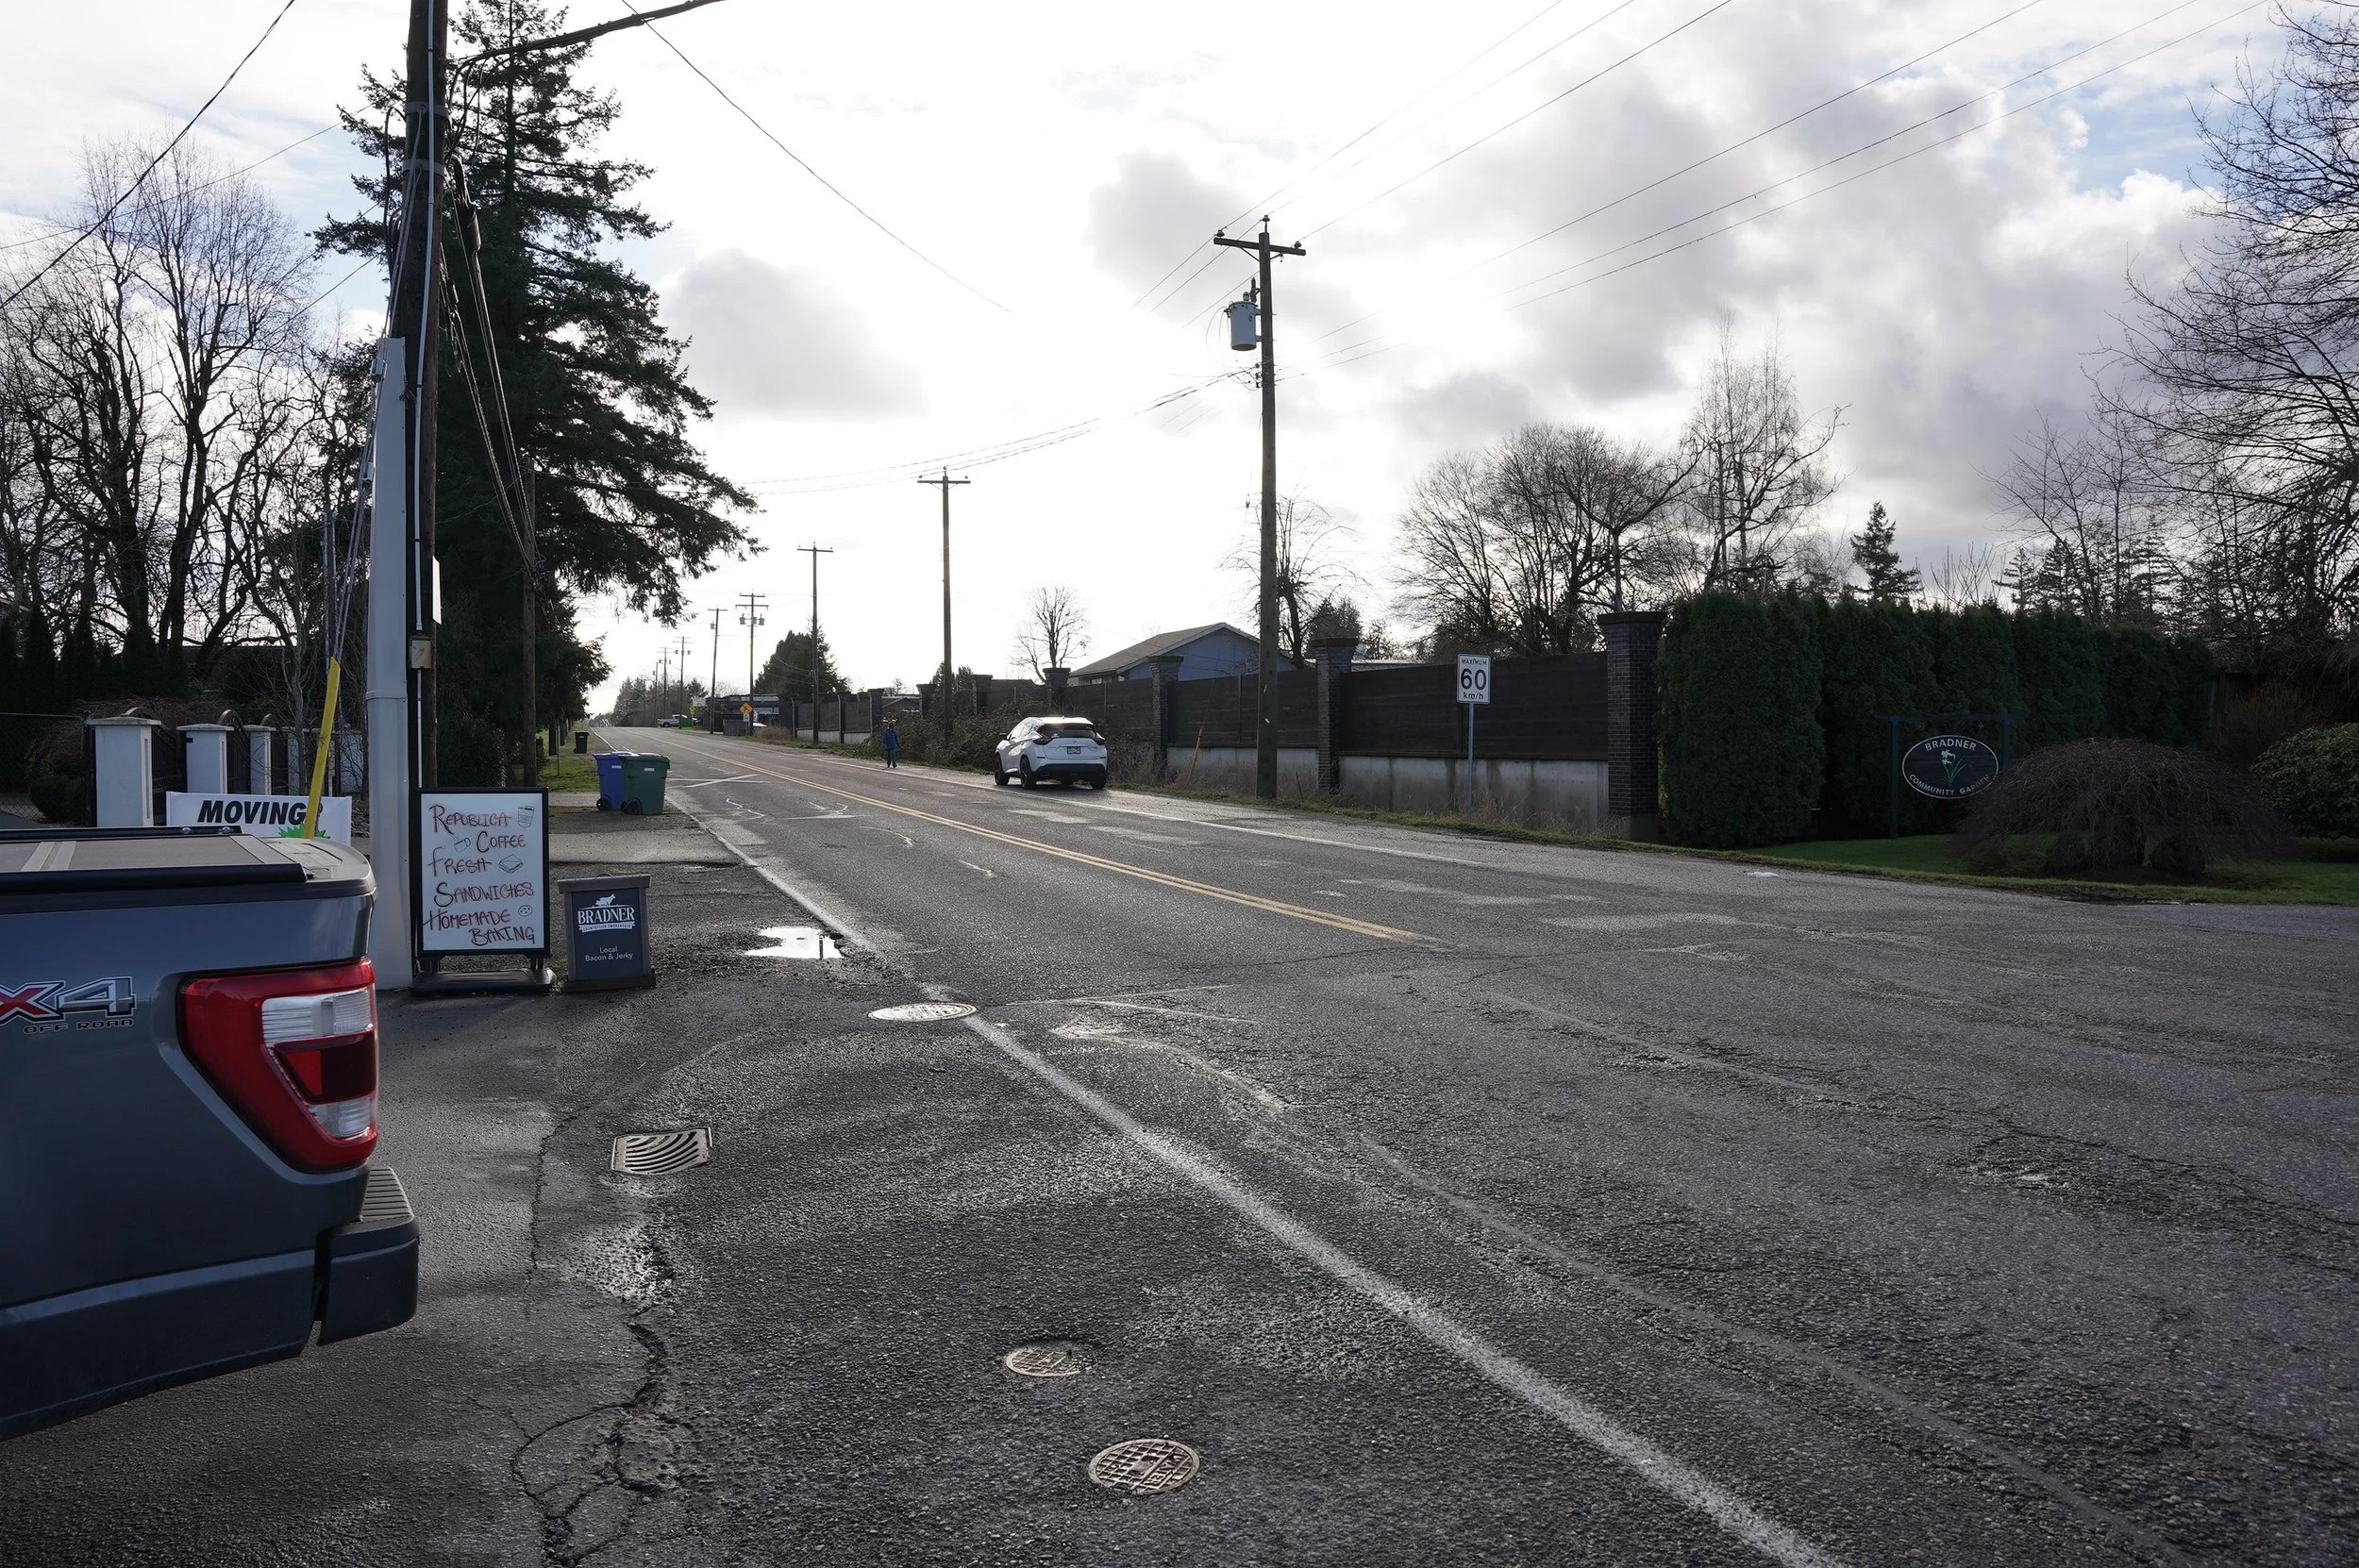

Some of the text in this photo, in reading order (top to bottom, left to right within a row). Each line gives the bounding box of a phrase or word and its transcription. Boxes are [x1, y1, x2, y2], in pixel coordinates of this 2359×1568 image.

[1461, 668, 1487, 691] 60
[1464, 692, 1483, 700] km/h
[1924, 738, 1977, 751] BRADNER
[1909, 774, 1954, 795] COMMUNITY
[428, 805, 512, 835] REPUBLICA
[477, 831, 527, 853] COFFEE
[427, 846, 493, 877] FRESH
[434, 881, 535, 908] SANDWICHES
[423, 909, 510, 931] HOMEMADE
[577, 907, 635, 925] BRADNER
[468, 926, 535, 946] BAKING
[599, 945, 618, 954] Local
[615, 952, 633, 960] Jerky
[24, 1018, 134, 1034] OFF ROAD
